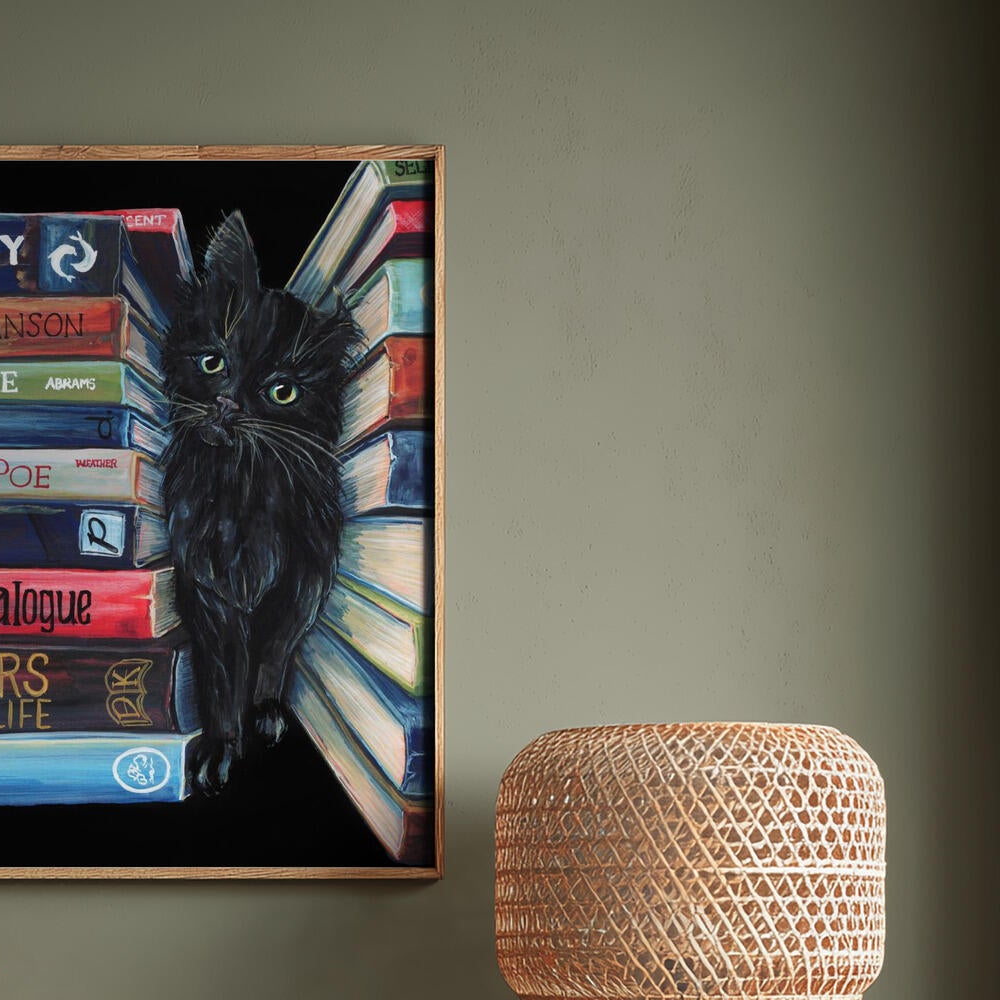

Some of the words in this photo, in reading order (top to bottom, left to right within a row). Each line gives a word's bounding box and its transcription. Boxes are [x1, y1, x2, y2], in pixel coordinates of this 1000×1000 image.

[44, 376, 97, 392] ABRAMS
[74, 457, 118, 469] WEATHER
[110, 665, 143, 720] DK
